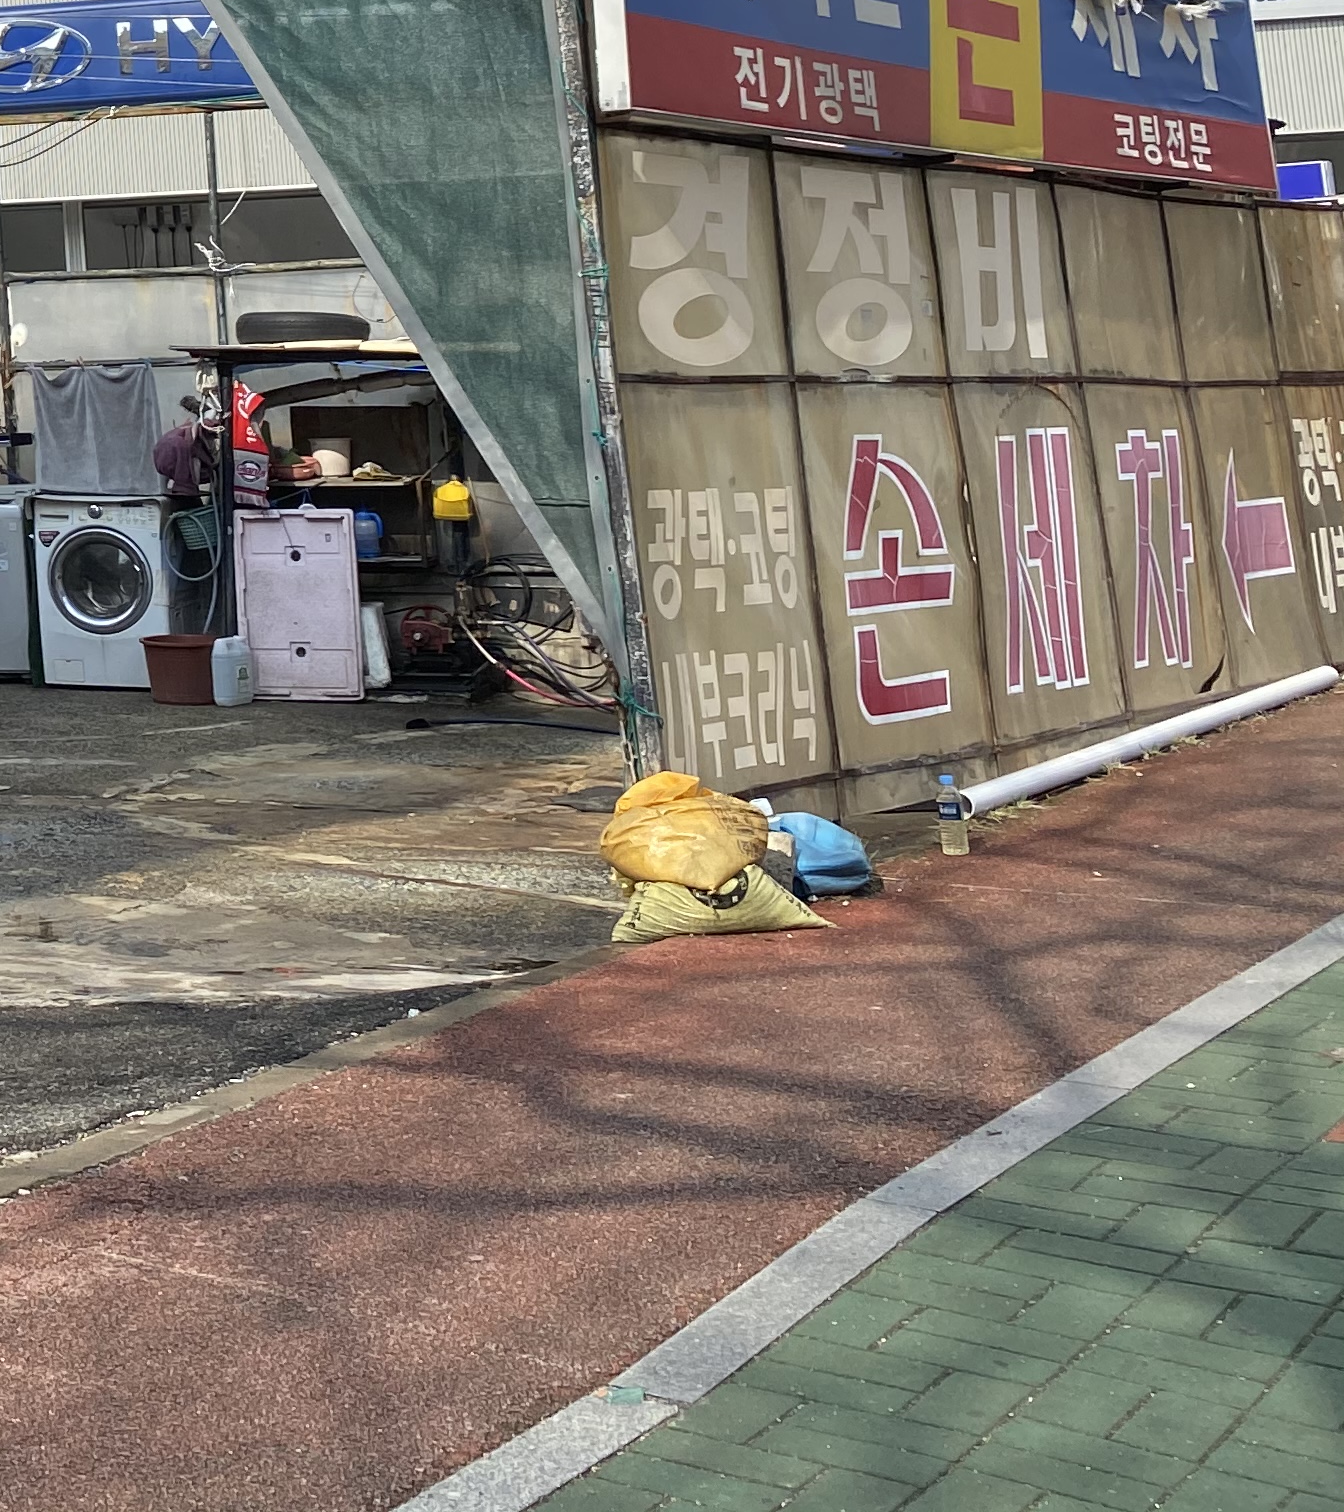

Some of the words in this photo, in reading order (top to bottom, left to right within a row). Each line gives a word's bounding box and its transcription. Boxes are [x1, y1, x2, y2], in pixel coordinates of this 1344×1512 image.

[732, 44, 881, 132] 전기광택
[1114, 112, 1213, 174] 코팅전문
[629, 150, 1048, 367] 경정비
